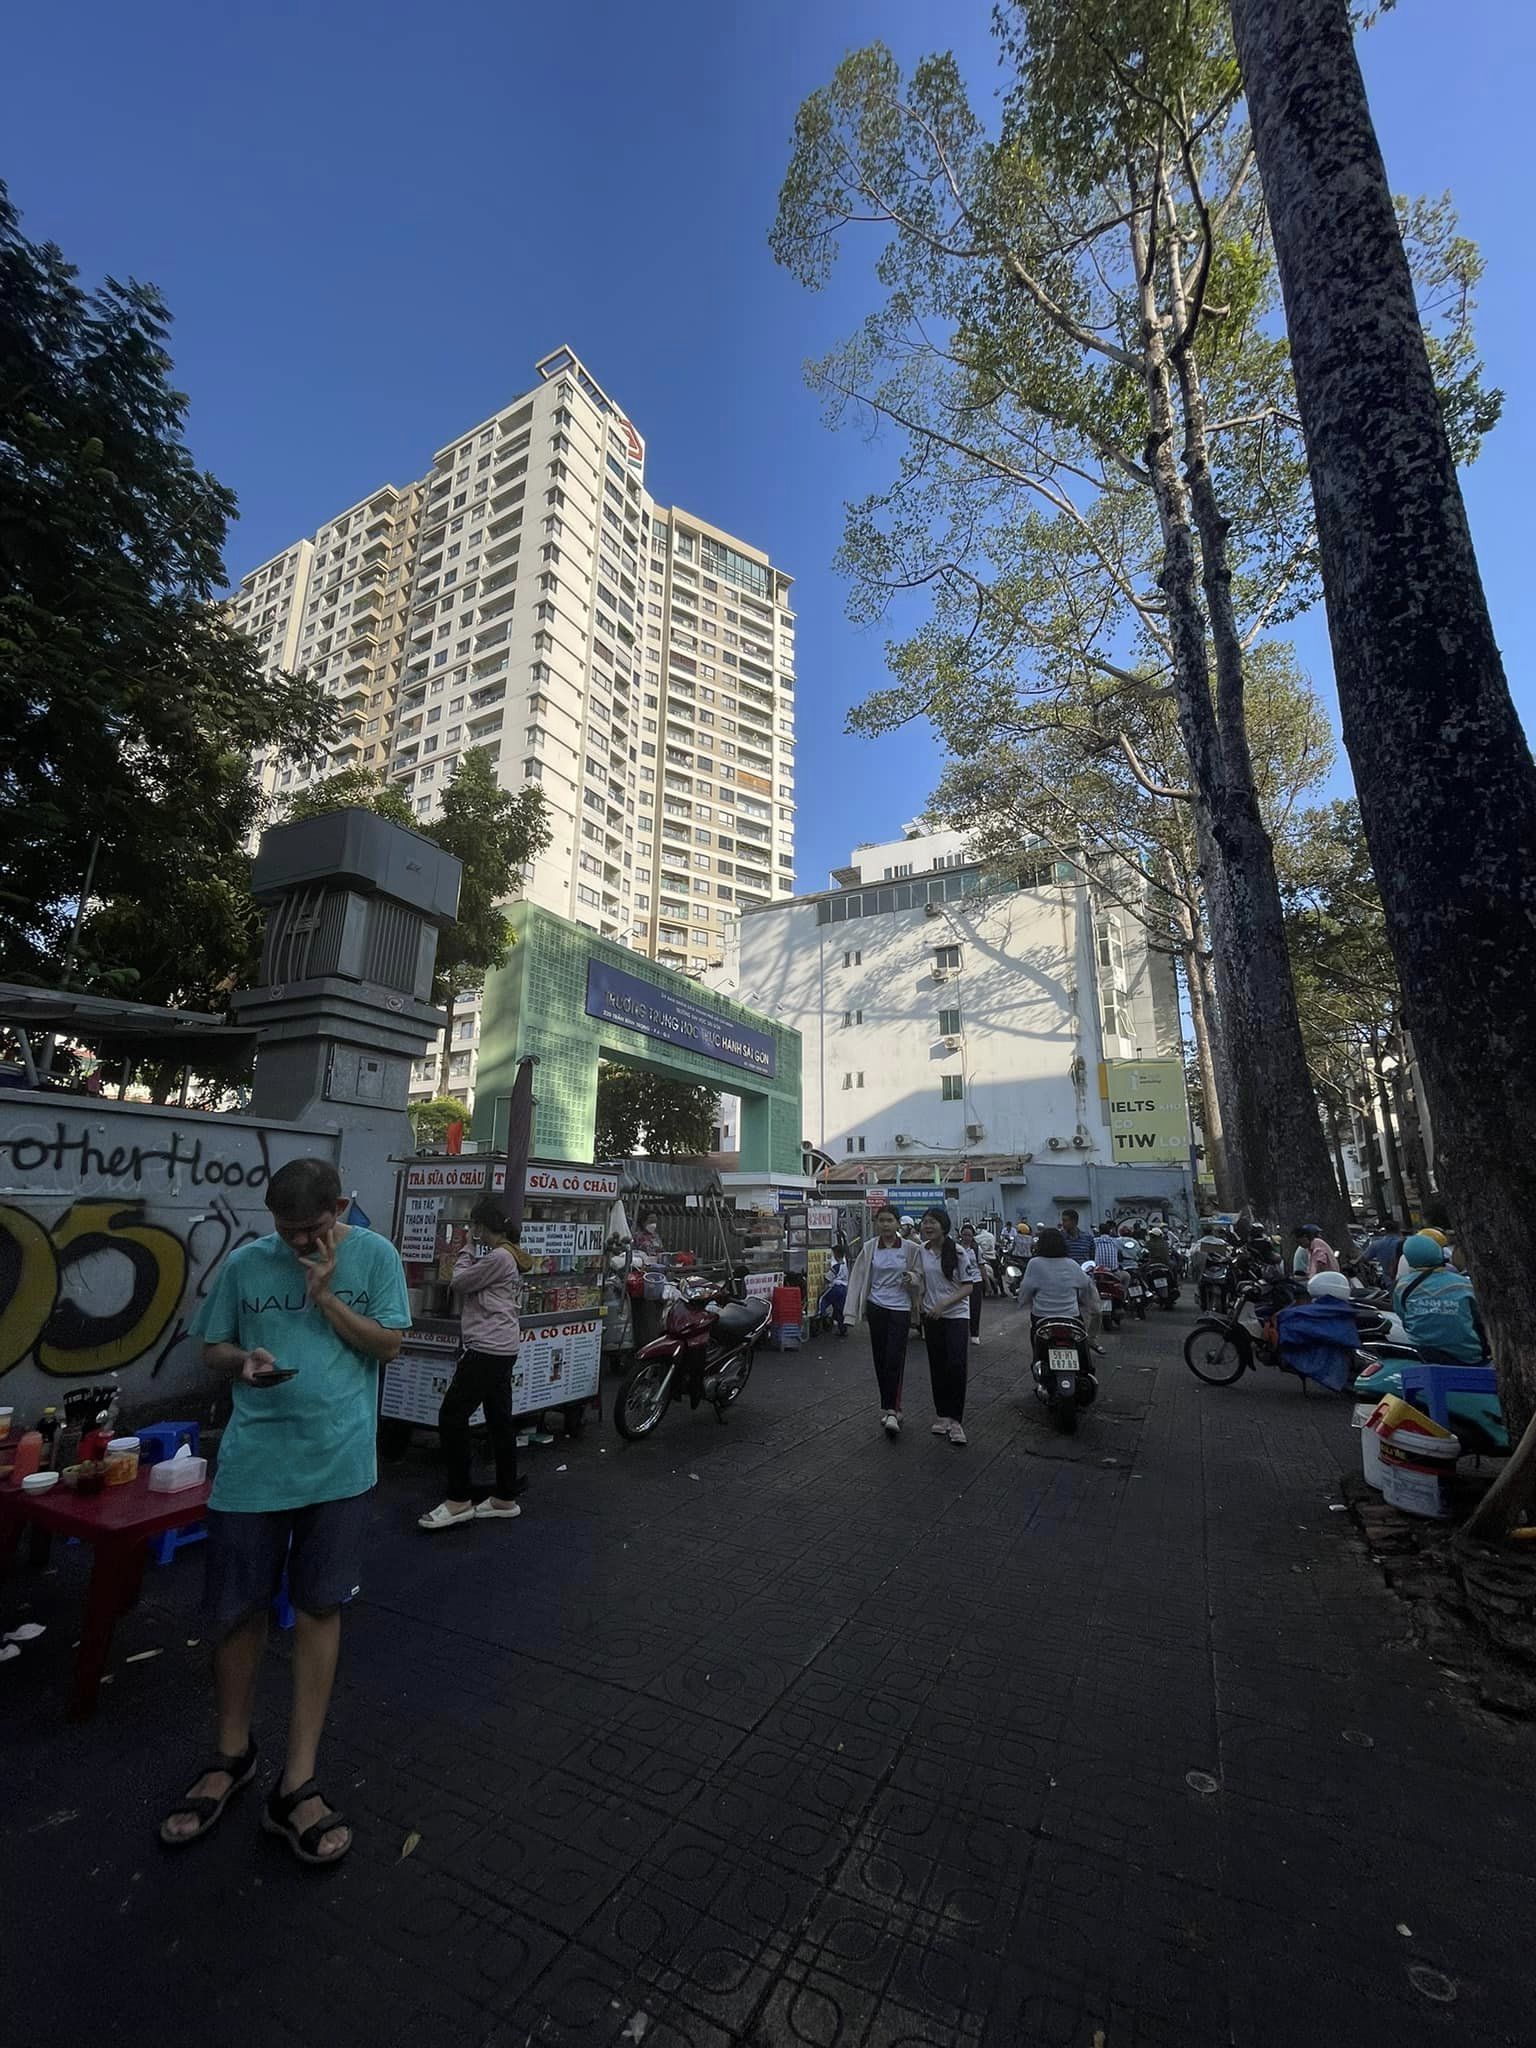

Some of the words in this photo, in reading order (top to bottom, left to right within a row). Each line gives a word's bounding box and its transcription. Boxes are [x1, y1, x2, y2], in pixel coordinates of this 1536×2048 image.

[1111, 1100, 1155, 1113] IELTS
[1114, 1133, 1156, 1149] TIW
[529, 1172, 558, 1190] SỮA
[562, 1175, 580, 1191] CÔ
[583, 1178, 617, 1193] CHÂU
[241, 1290, 371, 1315] NAUCA
